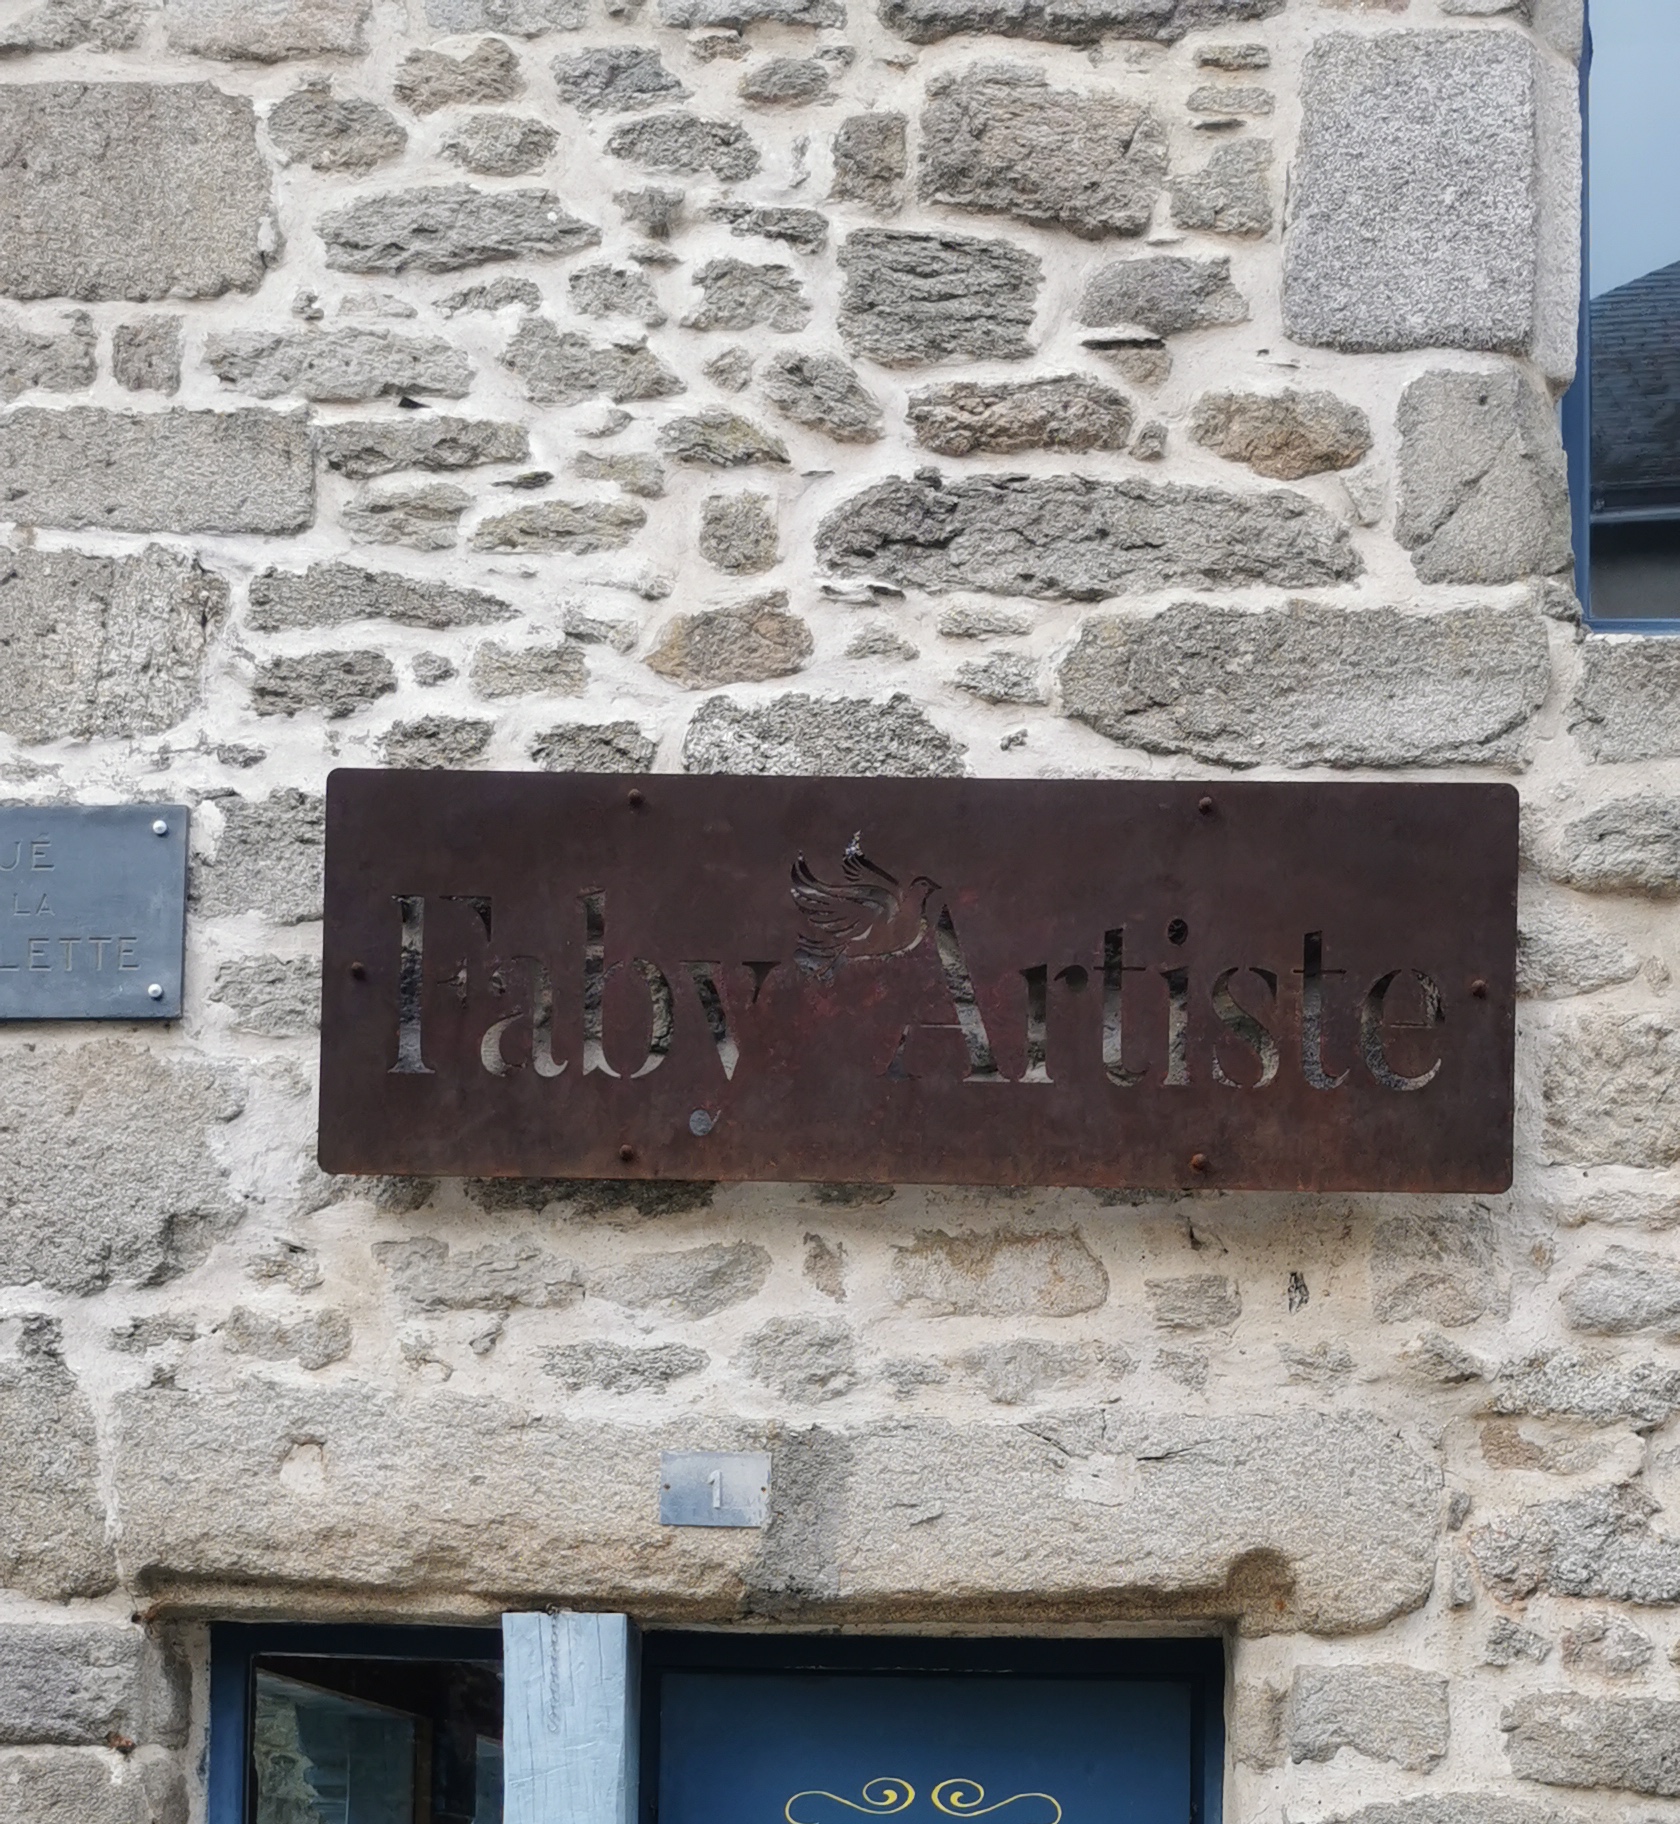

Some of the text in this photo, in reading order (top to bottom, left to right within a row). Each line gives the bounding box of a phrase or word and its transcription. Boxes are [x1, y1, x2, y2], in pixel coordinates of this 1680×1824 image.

[12, 892, 56, 917] LA
[386, 884, 1446, 1138] Faby Artiste
[706, 1469, 722, 1510] 1
